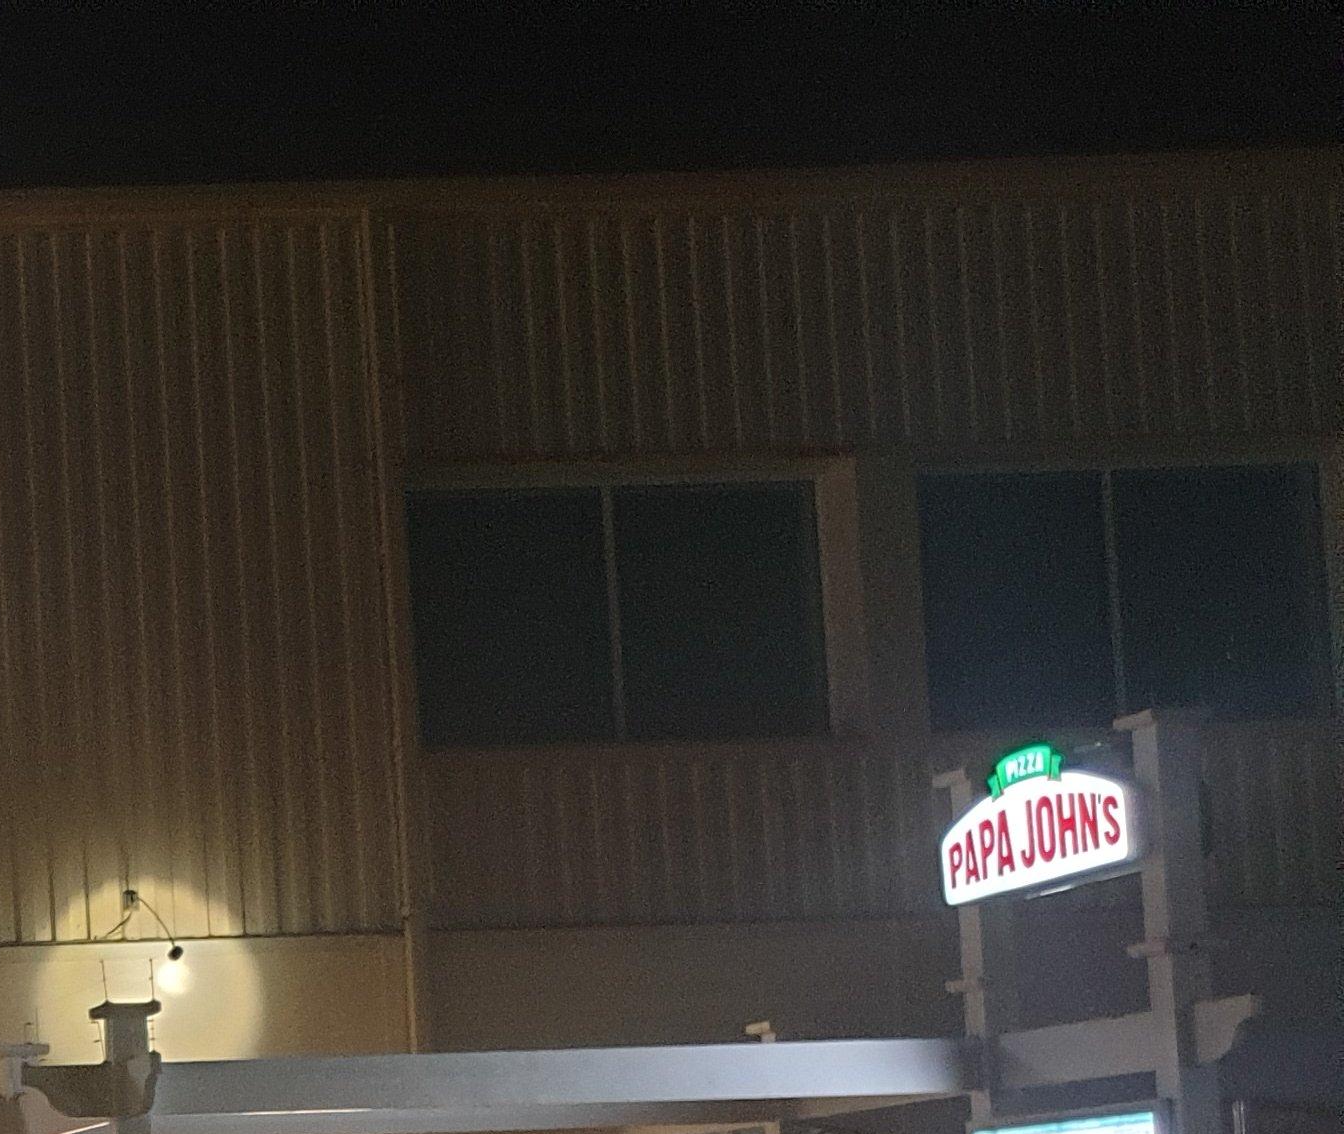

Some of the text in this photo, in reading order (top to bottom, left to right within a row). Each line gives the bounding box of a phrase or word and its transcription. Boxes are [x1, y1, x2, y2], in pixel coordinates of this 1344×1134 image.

[1006, 750, 1044, 782] PIZZA
[949, 792, 1121, 889] PAPA JOHN'S
